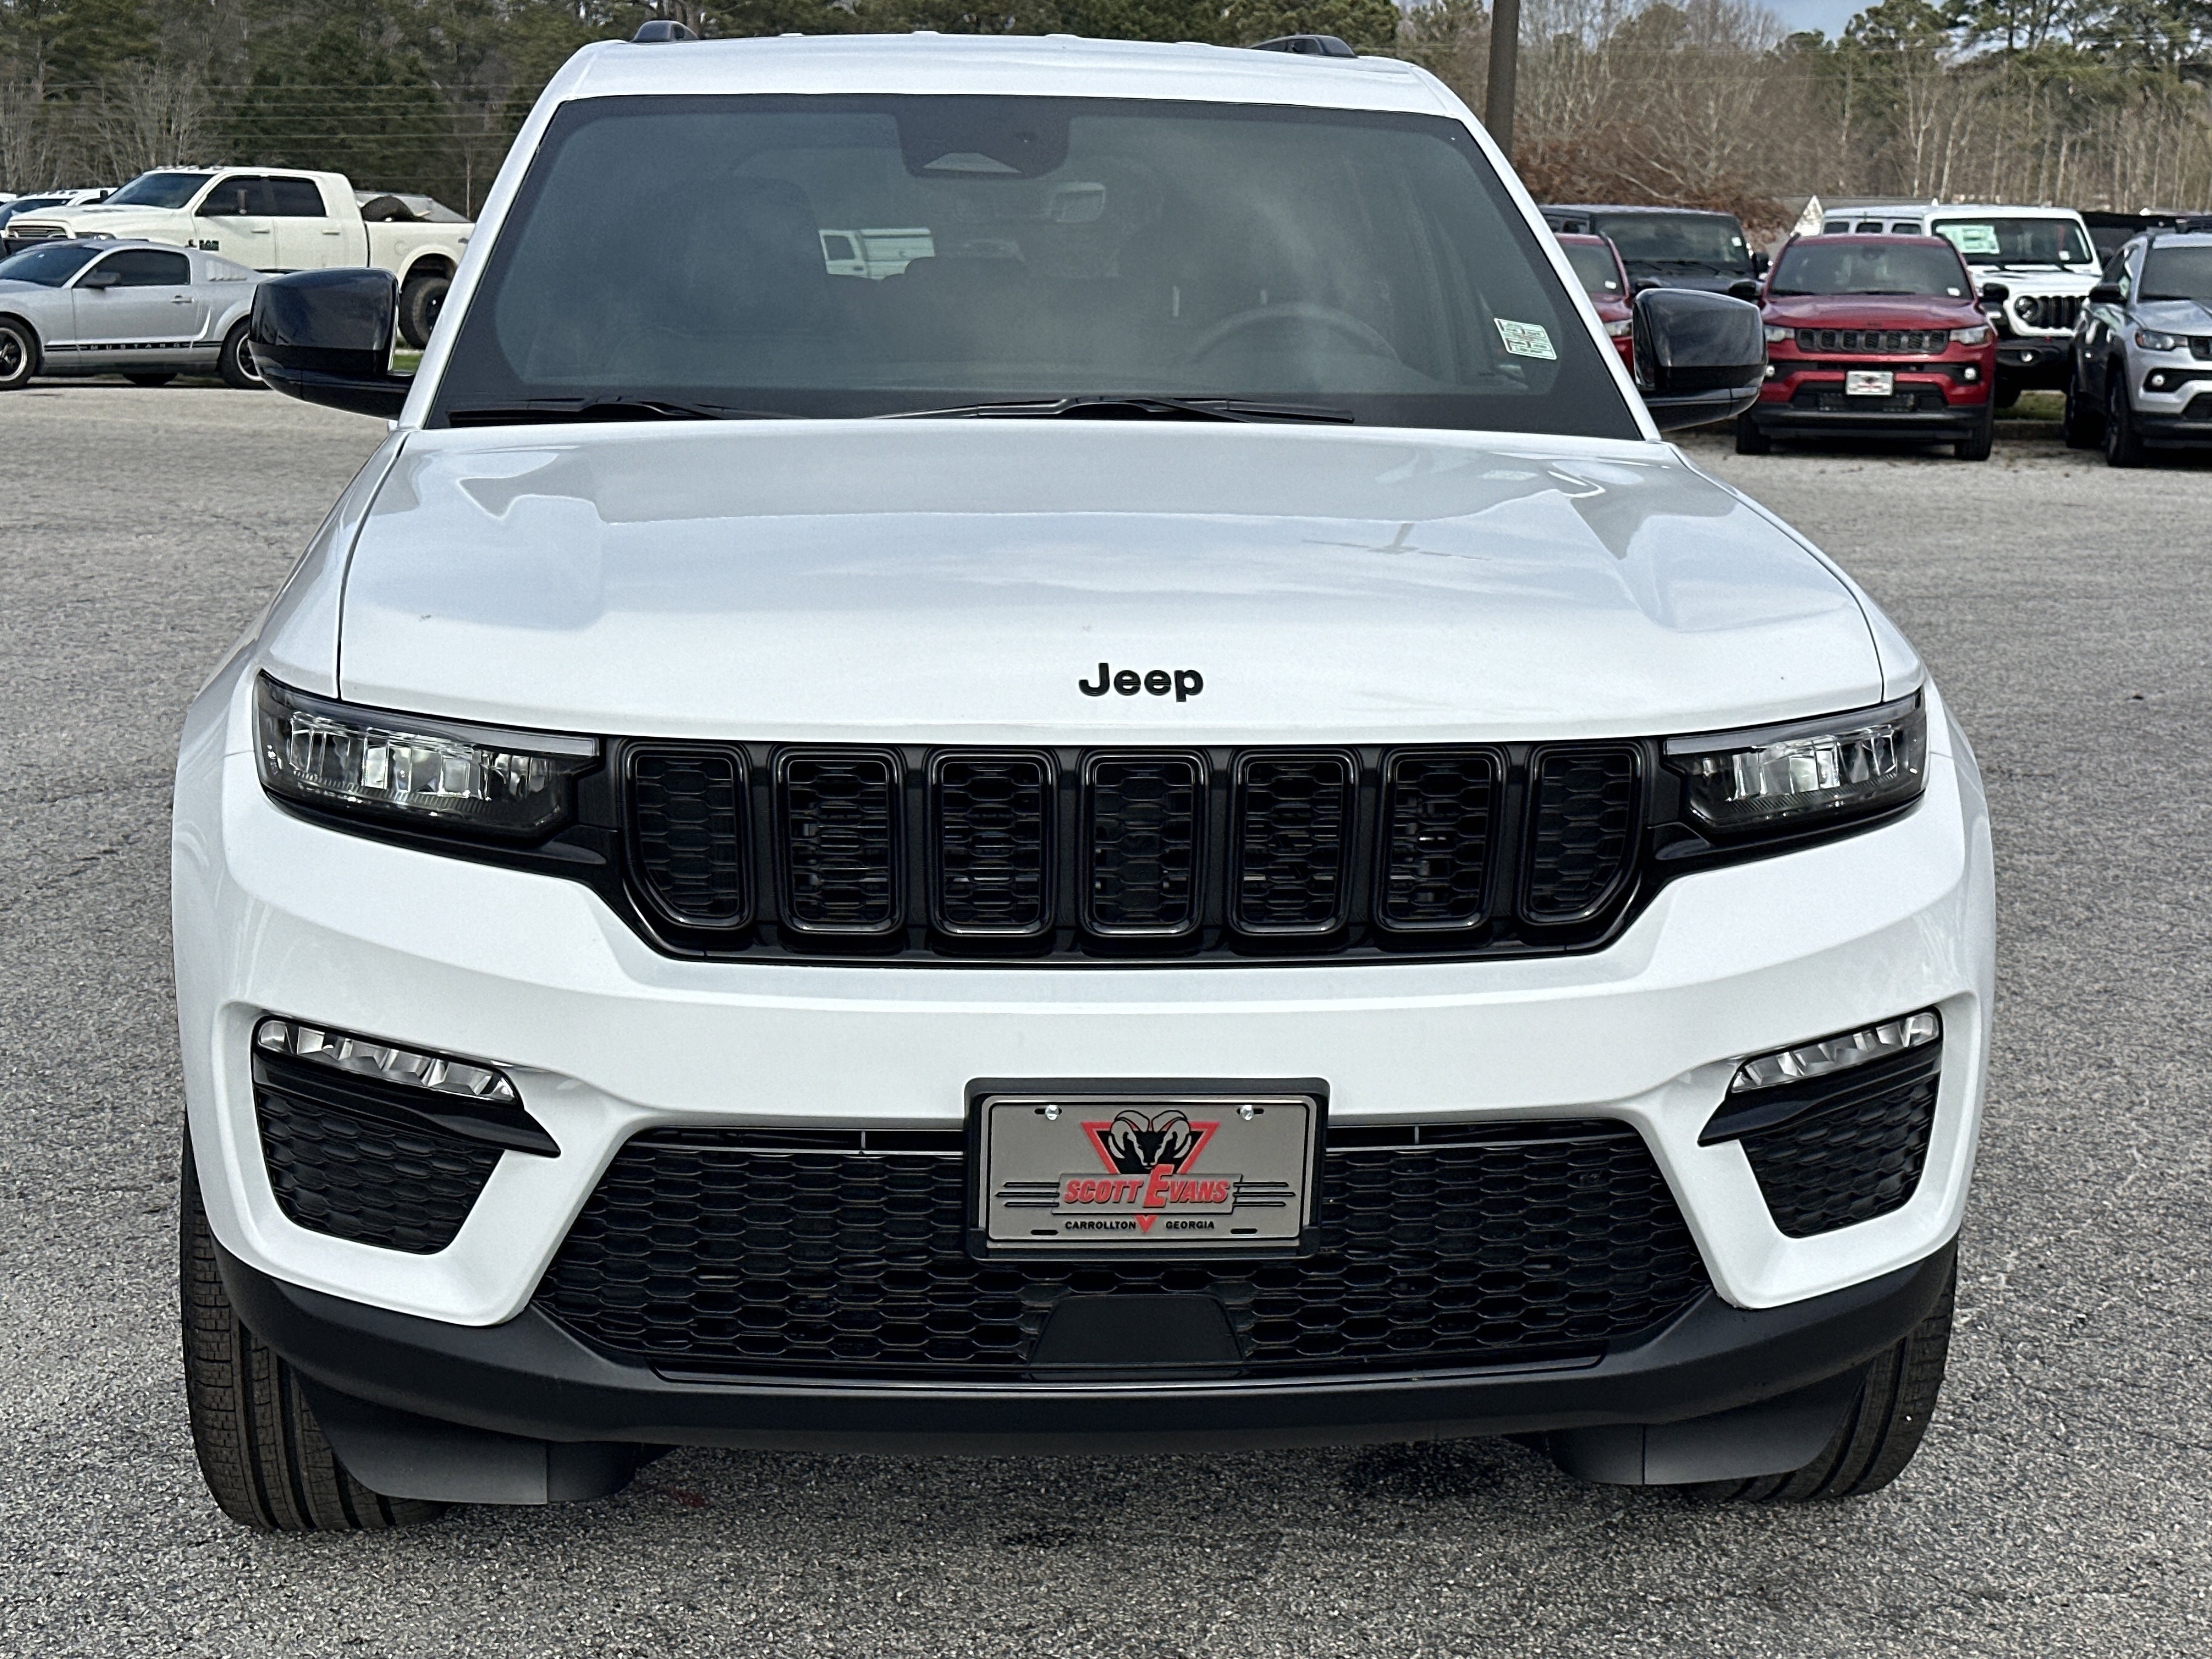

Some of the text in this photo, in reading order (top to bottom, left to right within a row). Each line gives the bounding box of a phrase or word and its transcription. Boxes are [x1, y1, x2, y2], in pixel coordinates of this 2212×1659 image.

[1079, 662, 1204, 703] Jeep
[1064, 1164, 1229, 1208] SCOTT EVANS
[1065, 1221, 1215, 1230] CARROLLTON GEORGIA
